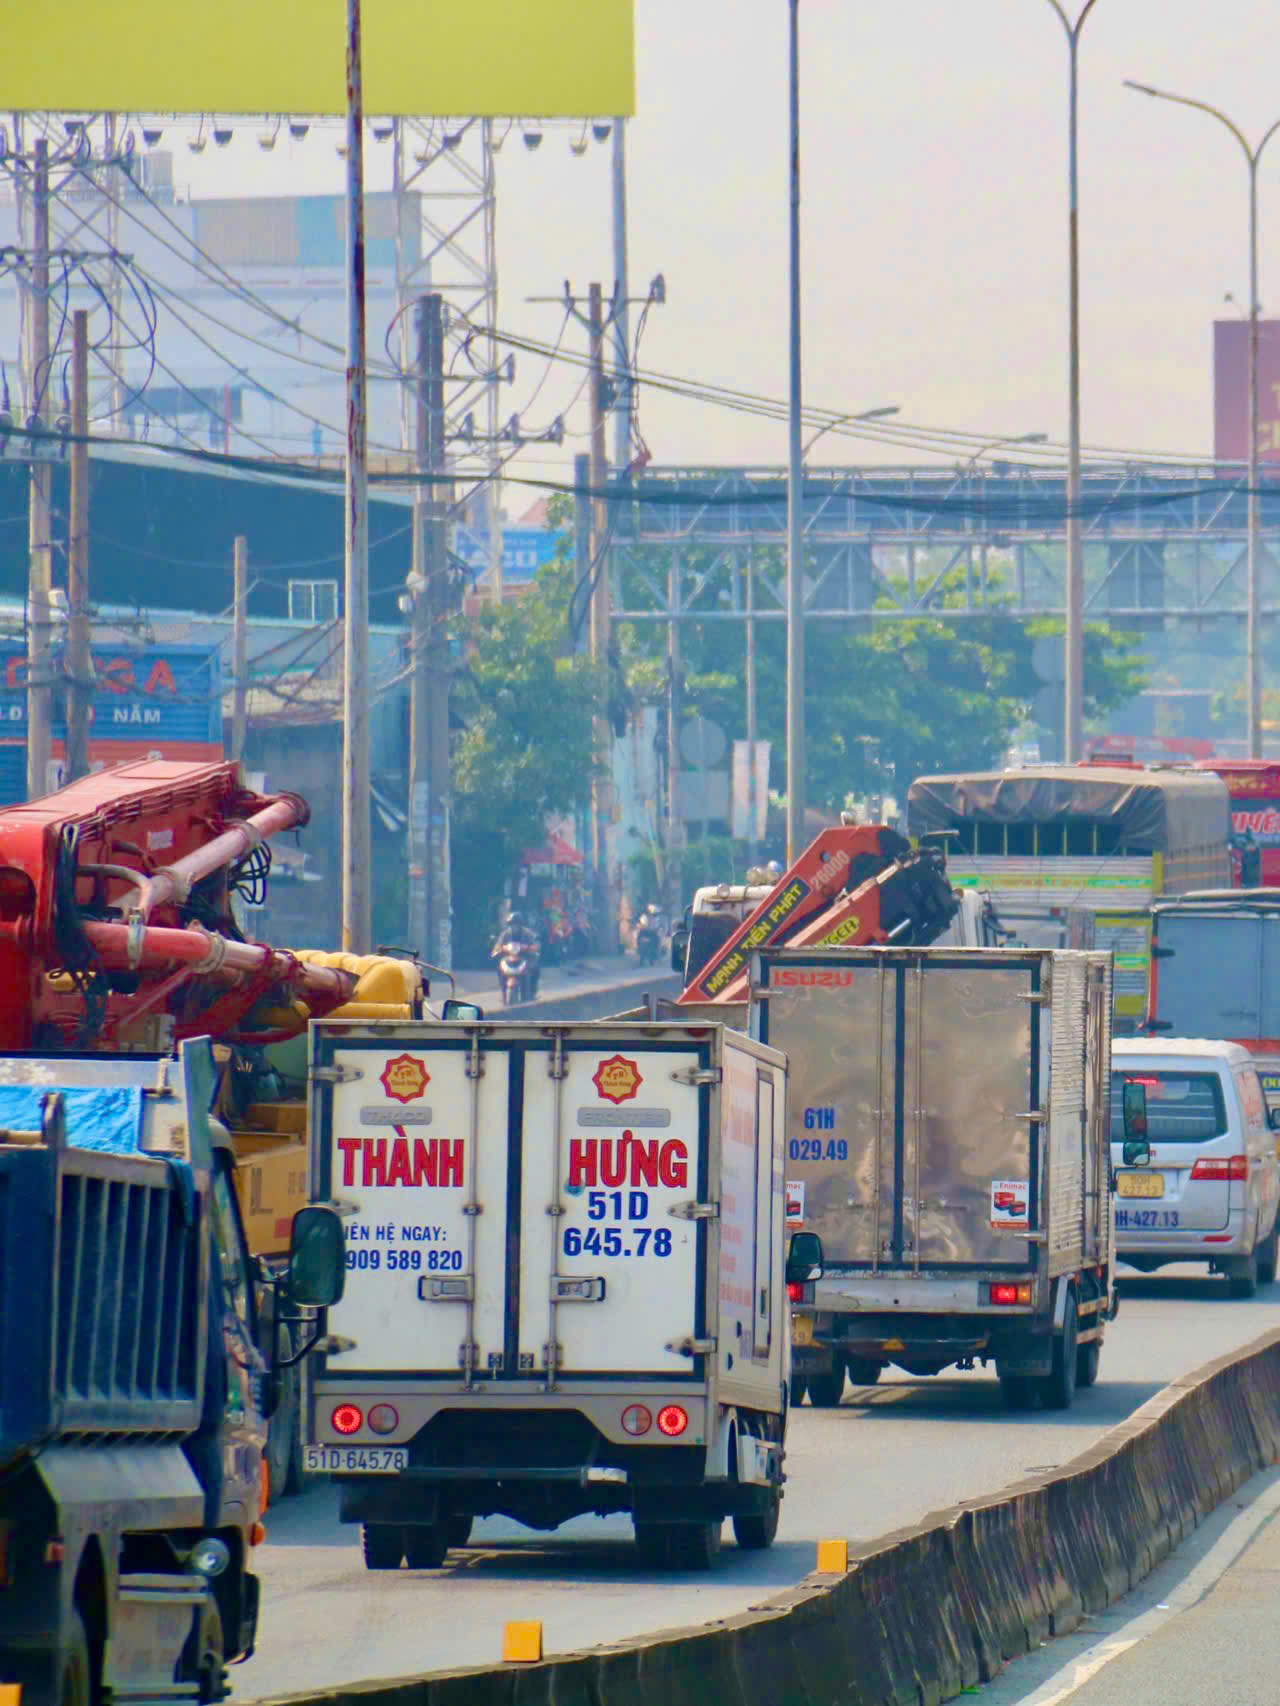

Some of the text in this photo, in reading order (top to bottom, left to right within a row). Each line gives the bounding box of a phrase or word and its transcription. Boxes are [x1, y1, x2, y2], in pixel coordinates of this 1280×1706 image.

[773, 971, 854, 987] ISUZU
[804, 1107, 835, 1130] 61H
[337, 1125, 465, 1187] THÀNH
[569, 1129, 688, 1188] HƯNG
[788, 1139, 848, 1161] 029.49
[588, 1191, 649, 1221] 51D
[344, 1222, 447, 1244] IÊN HỆ NGAY:
[563, 1227, 672, 1257] 645.78
[344, 1250, 463, 1270] 909 589 820
